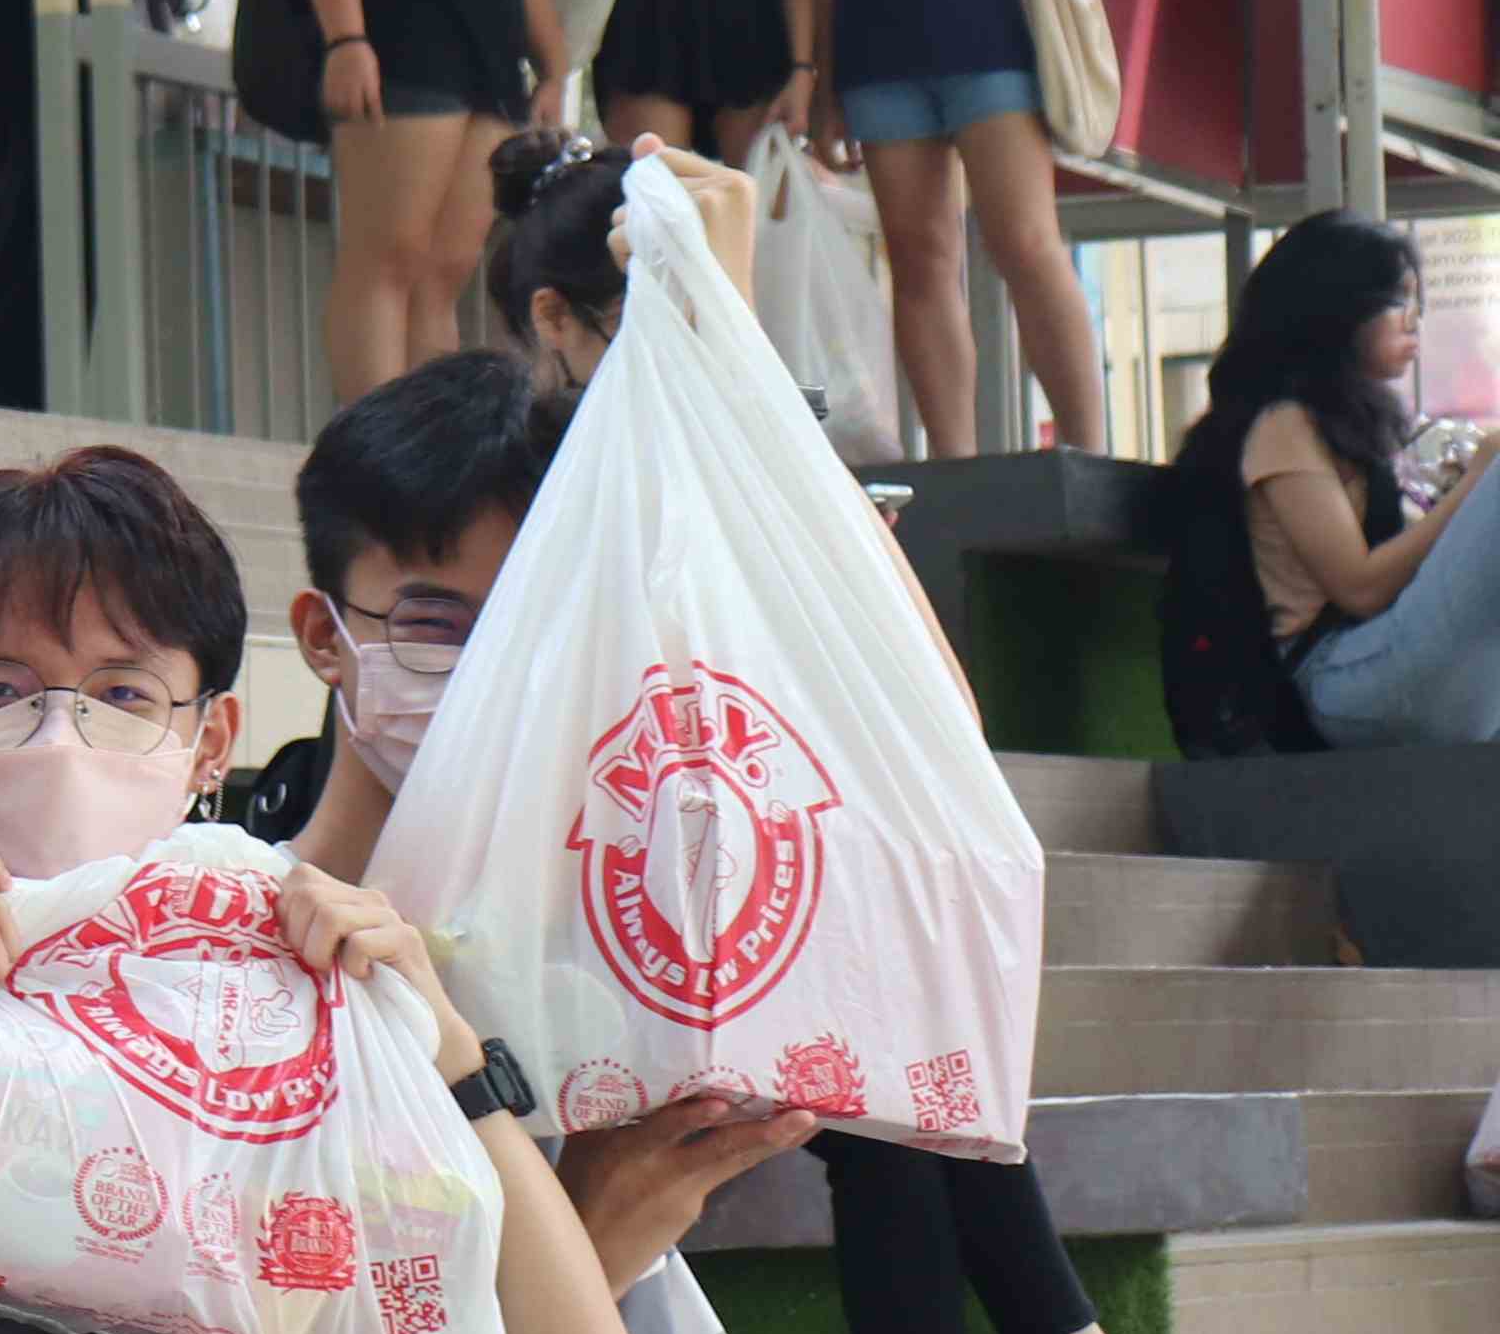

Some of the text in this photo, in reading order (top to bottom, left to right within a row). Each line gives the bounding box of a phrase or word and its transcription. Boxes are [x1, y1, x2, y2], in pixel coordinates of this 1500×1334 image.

[694, 957, 740, 997] Lw
[736, 839, 796, 964] Prices
[576, 1097, 629, 1111] BRAND
[94, 1180, 151, 1202] BRAND
[91, 1192, 150, 1218] OF THE
